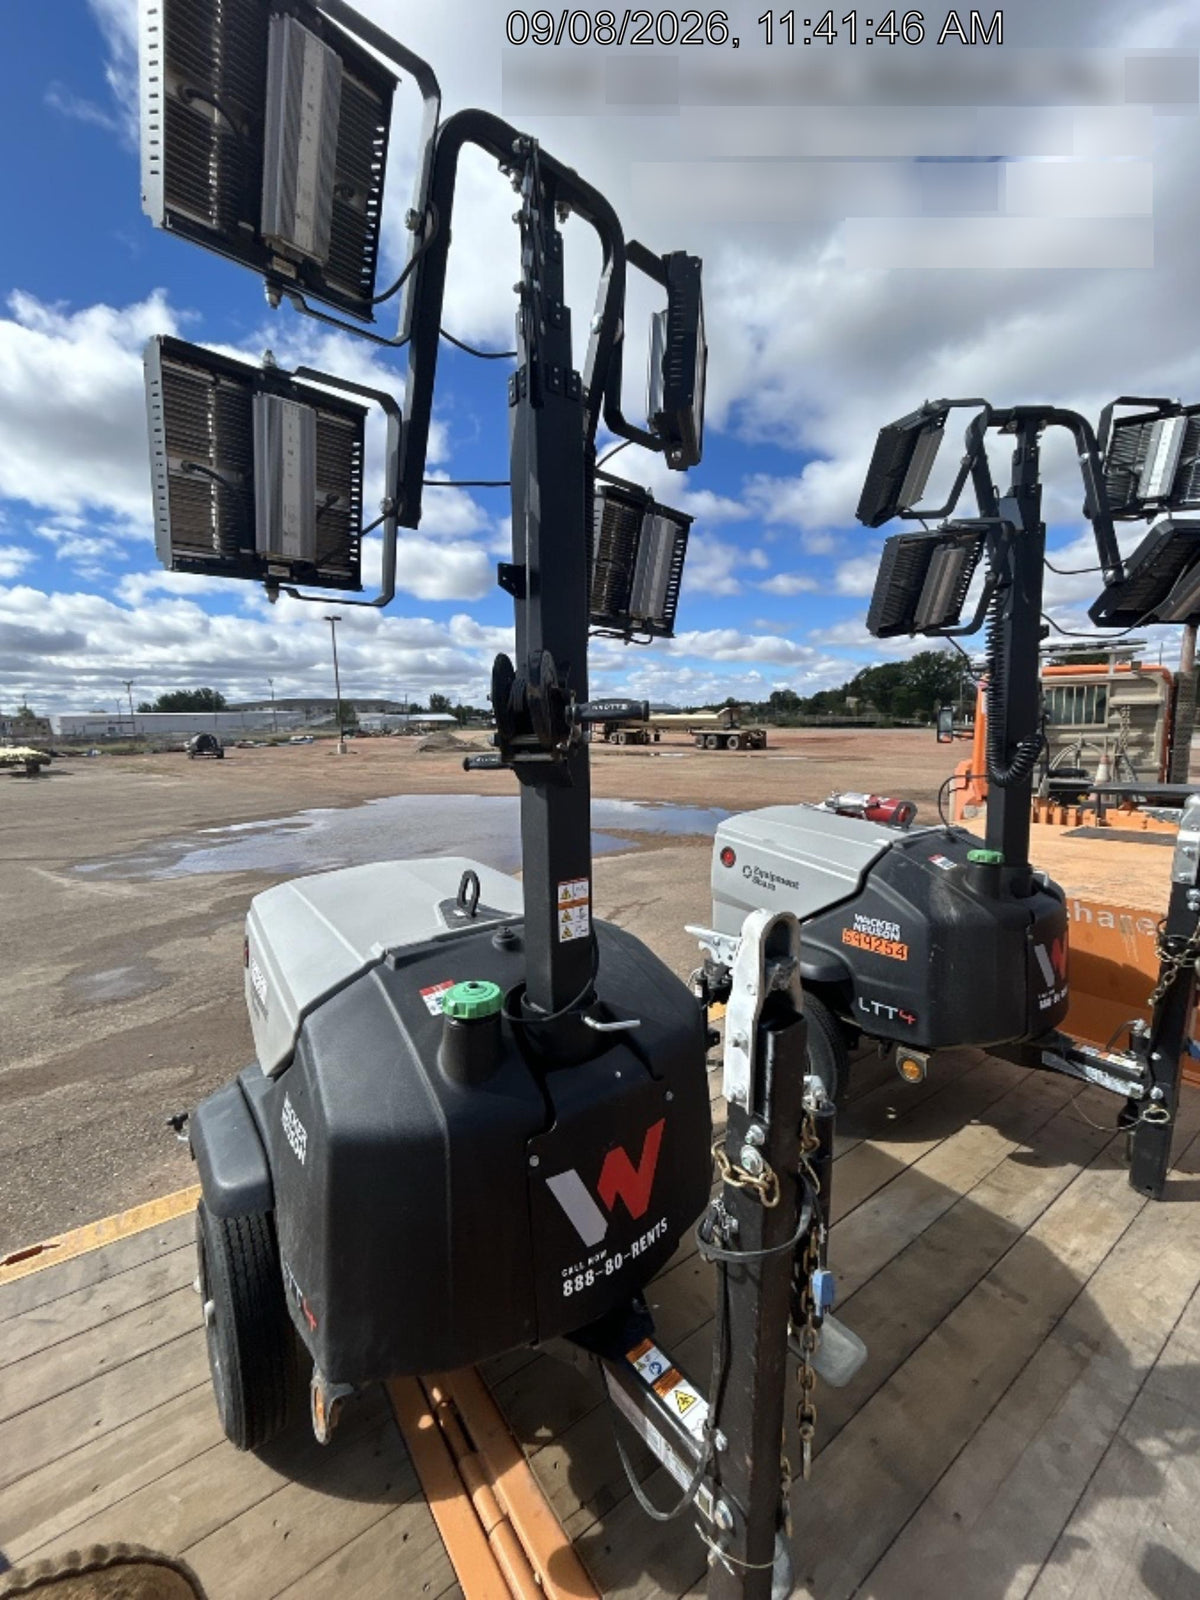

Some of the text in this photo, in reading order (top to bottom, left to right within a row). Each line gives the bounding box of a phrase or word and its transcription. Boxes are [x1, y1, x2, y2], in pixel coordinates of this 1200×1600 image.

[854, 913, 901, 933] WACKER
[858, 996, 917, 1025] LTT4
[561, 1249, 607, 1278] CALL NOW
[562, 1217, 668, 1297] 888-80-RENTS
